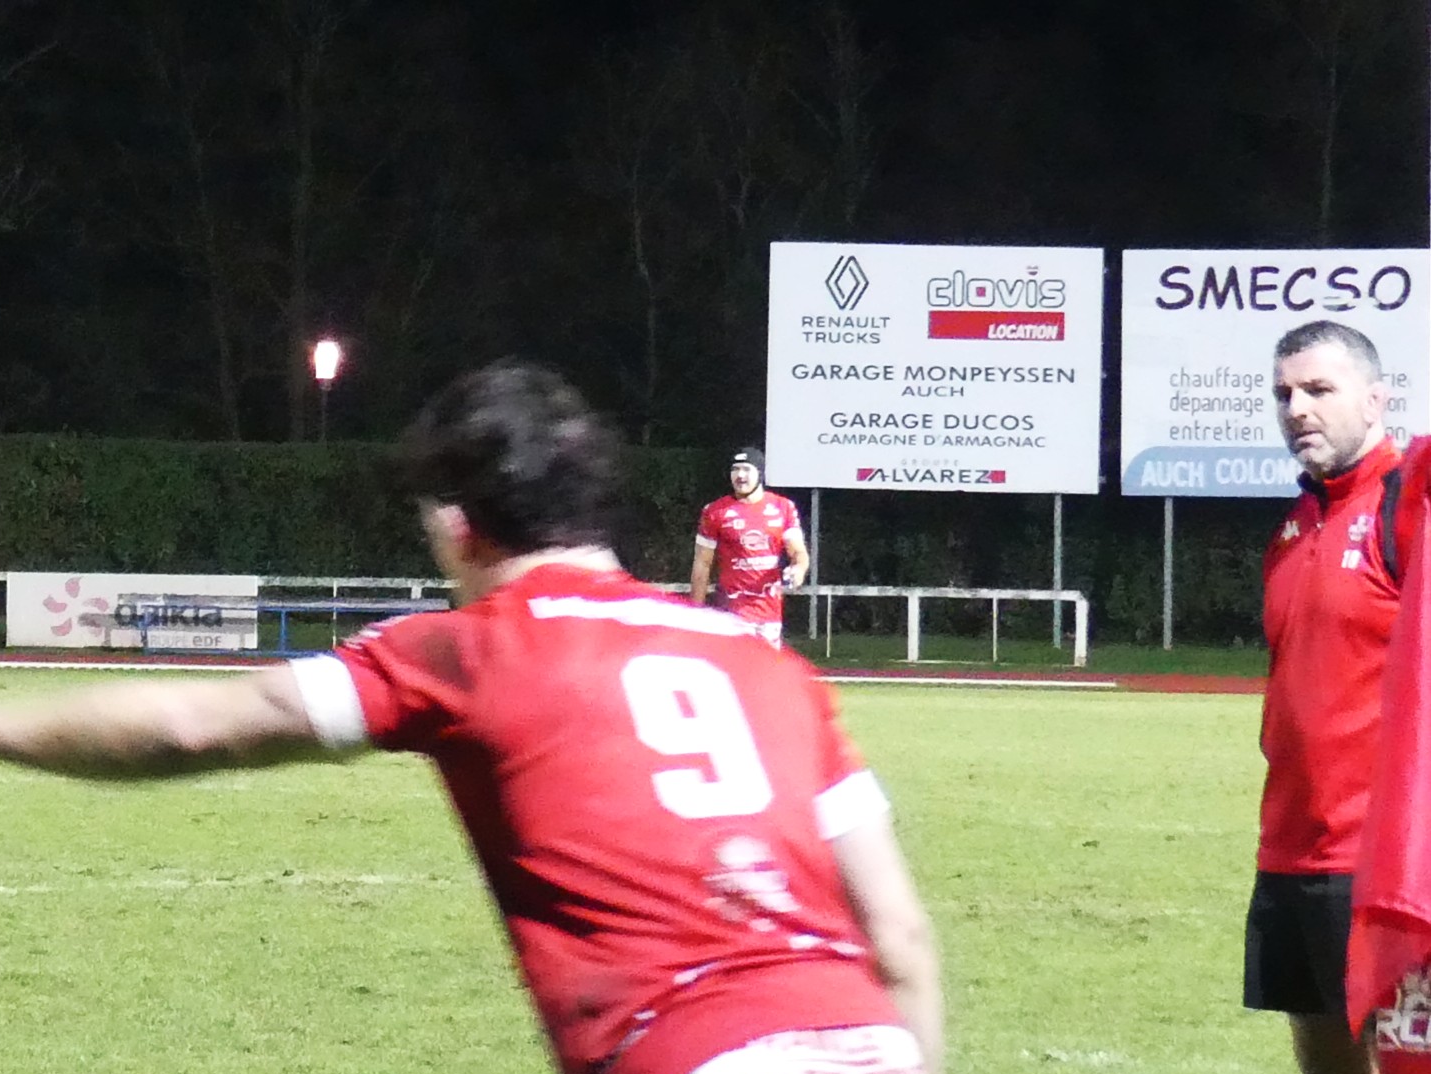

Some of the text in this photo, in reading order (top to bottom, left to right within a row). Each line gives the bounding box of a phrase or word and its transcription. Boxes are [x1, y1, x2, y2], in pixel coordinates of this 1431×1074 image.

[927, 266, 1066, 309] clovis
[1155, 265, 1412, 312] SMECSO
[801, 316, 891, 330] RENAULT
[987, 323, 1060, 340] LOCATION
[802, 331, 881, 344] TRUCKS
[791, 364, 1076, 384] GARAGE MONPEYSSEN
[1169, 366, 1265, 393] chauffage
[900, 385, 965, 398] AUCH
[1169, 390, 1265, 418] dépannage
[829, 412, 1035, 431] GARAGE DUCOS
[1169, 419, 1265, 441] entretien
[817, 433, 1047, 449] CAMPAGNE D'ARMAGNAC
[1140, 457, 1302, 488] AUCH COLOM
[620, 653, 775, 820] 9
